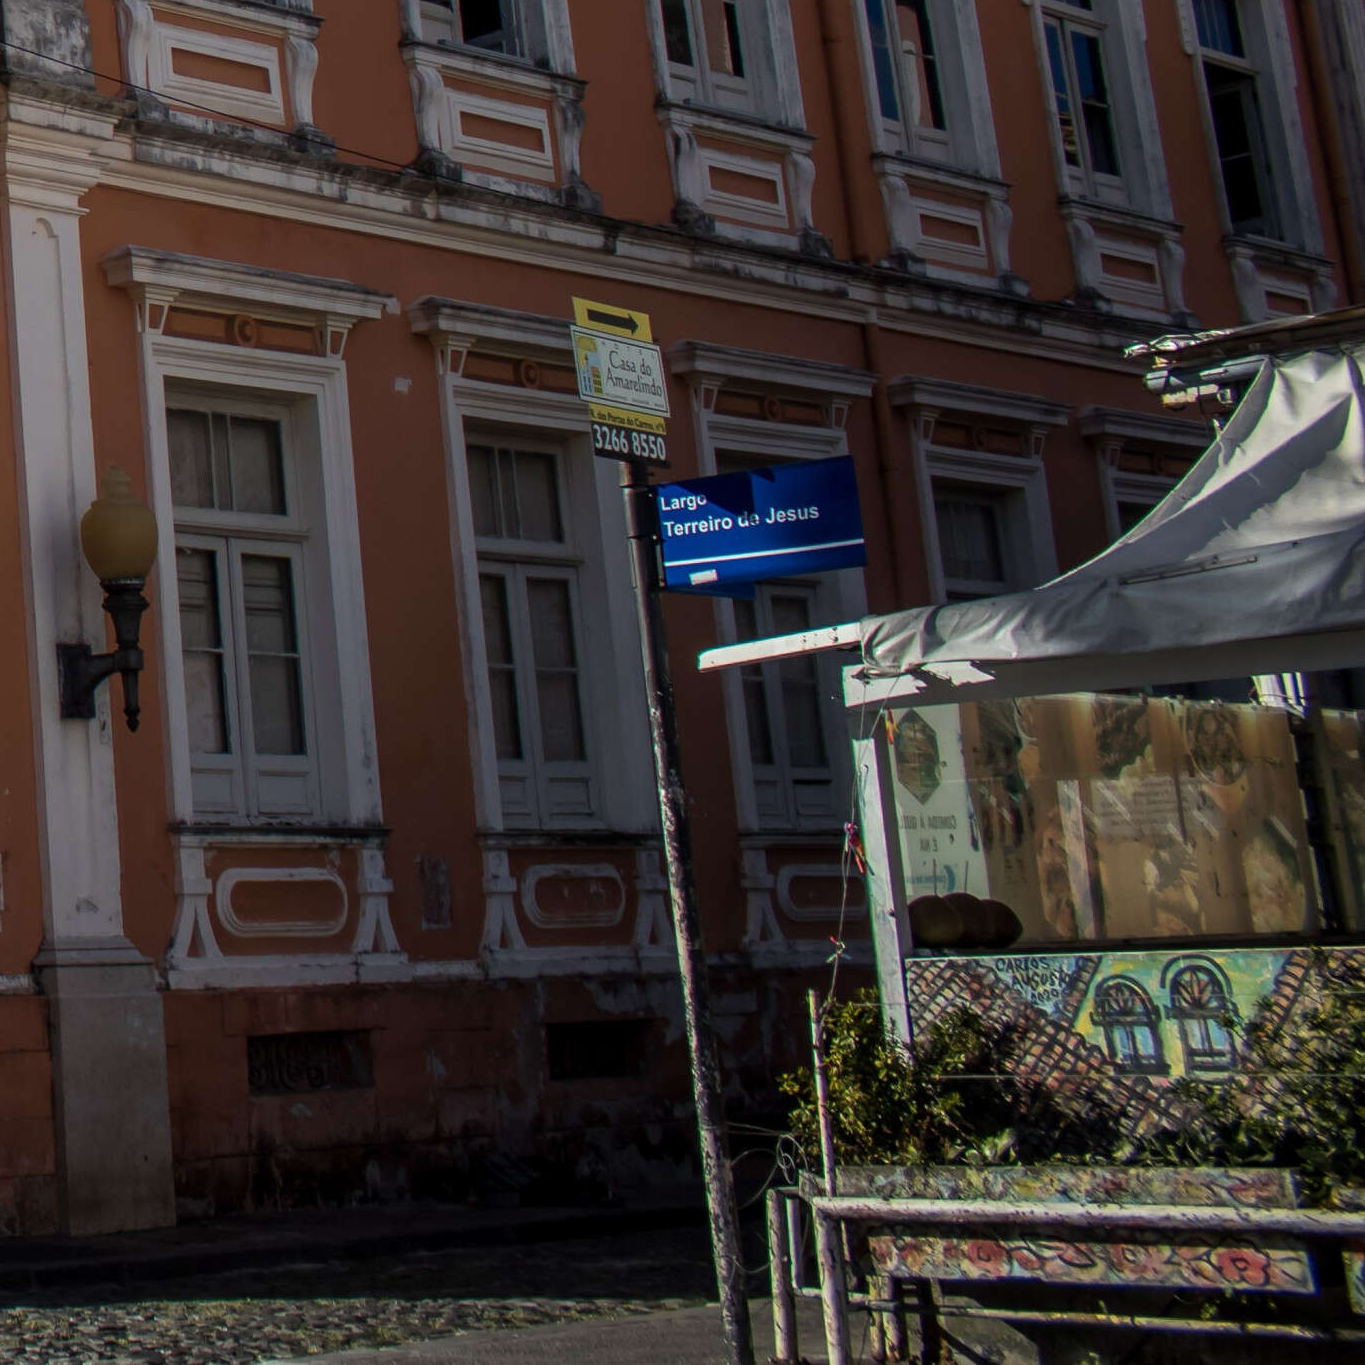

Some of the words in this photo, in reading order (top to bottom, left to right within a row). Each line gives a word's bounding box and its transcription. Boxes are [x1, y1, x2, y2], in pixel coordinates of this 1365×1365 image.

[609, 350, 636, 373] Casa
[640, 358, 652, 376] do
[606, 368, 662, 397] Amarelindo
[593, 424, 629, 453] 3266
[631, 432, 666, 461] 8550
[660, 495, 708, 511] Largo
[664, 516, 733, 537] Terreiro
[738, 511, 760, 527] de
[766, 506, 820, 524] Jesus
[996, 957, 1049, 973] CARLOS
